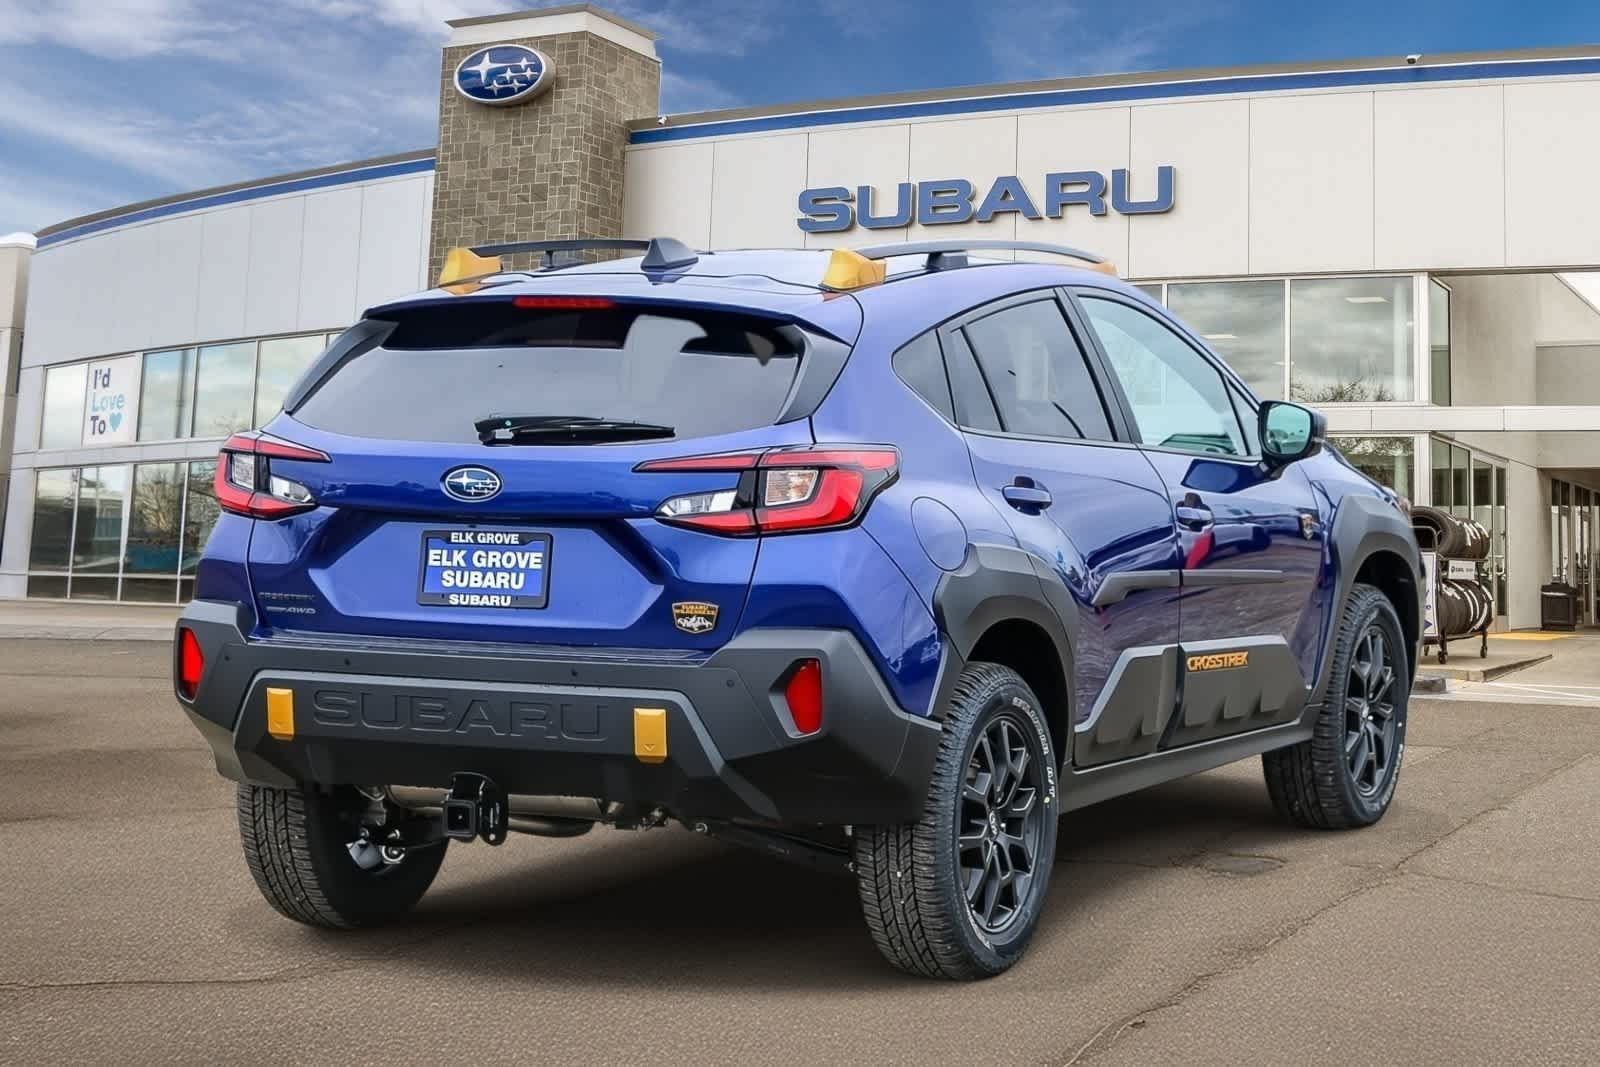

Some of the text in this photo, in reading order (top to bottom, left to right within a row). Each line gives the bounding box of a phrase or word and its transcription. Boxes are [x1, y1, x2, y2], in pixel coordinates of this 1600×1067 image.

[797, 166, 1175, 233] SUBARU
[93, 368, 111, 390] I'd
[92, 392, 125, 412] Love
[91, 416, 106, 435] To
[450, 532, 520, 545] ELK GROVE
[428, 549, 543, 569] ELK GROVE
[441, 570, 525, 590] SUBARU
[448, 594, 512, 607] SUBARU
[1186, 651, 1249, 671] CROSSTREK
[312, 689, 607, 742] SUBARU
